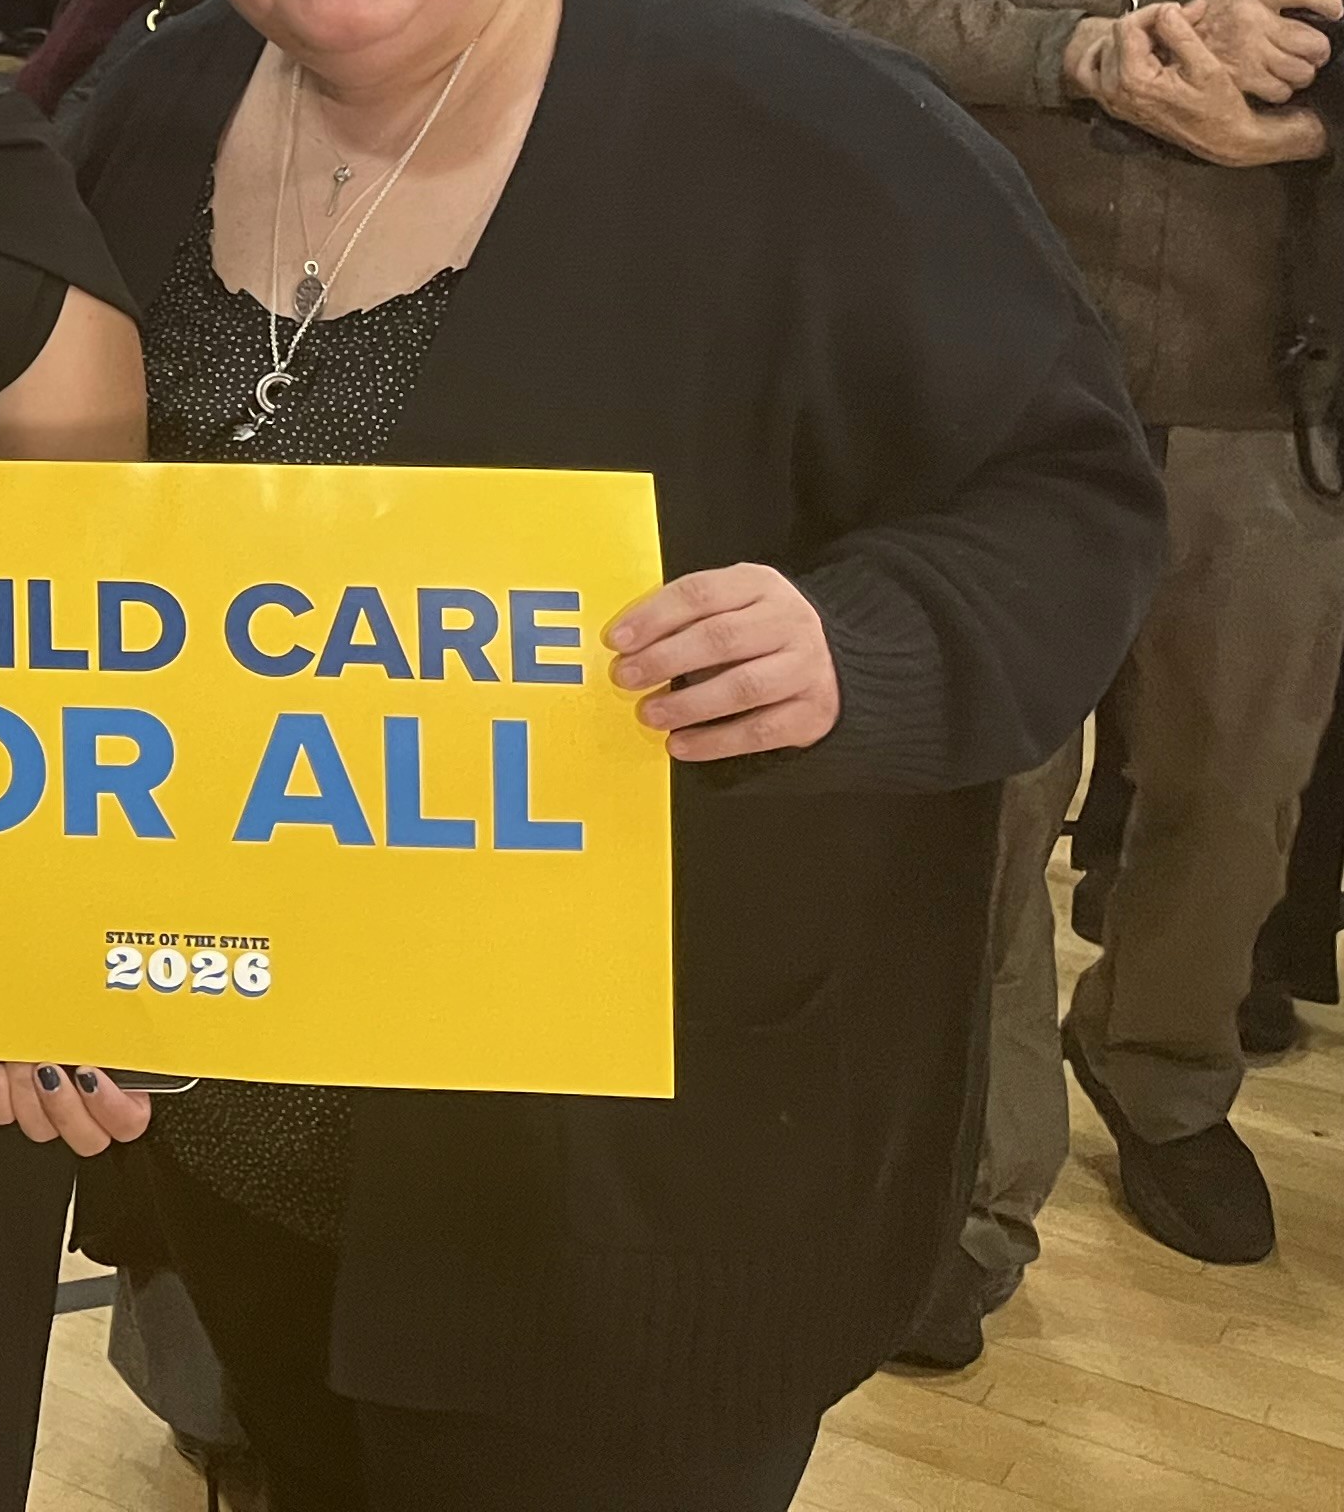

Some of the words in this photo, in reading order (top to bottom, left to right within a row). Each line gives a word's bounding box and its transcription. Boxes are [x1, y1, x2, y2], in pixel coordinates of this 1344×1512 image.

[224, 582, 584, 685] CARE
[231, 712, 584, 851] ALL
[105, 931, 155, 946] STATE
[159, 933, 179, 946] OF
[183, 934, 216, 948] THE
[219, 935, 270, 950] STATE
[105, 946, 271, 998] 2026
